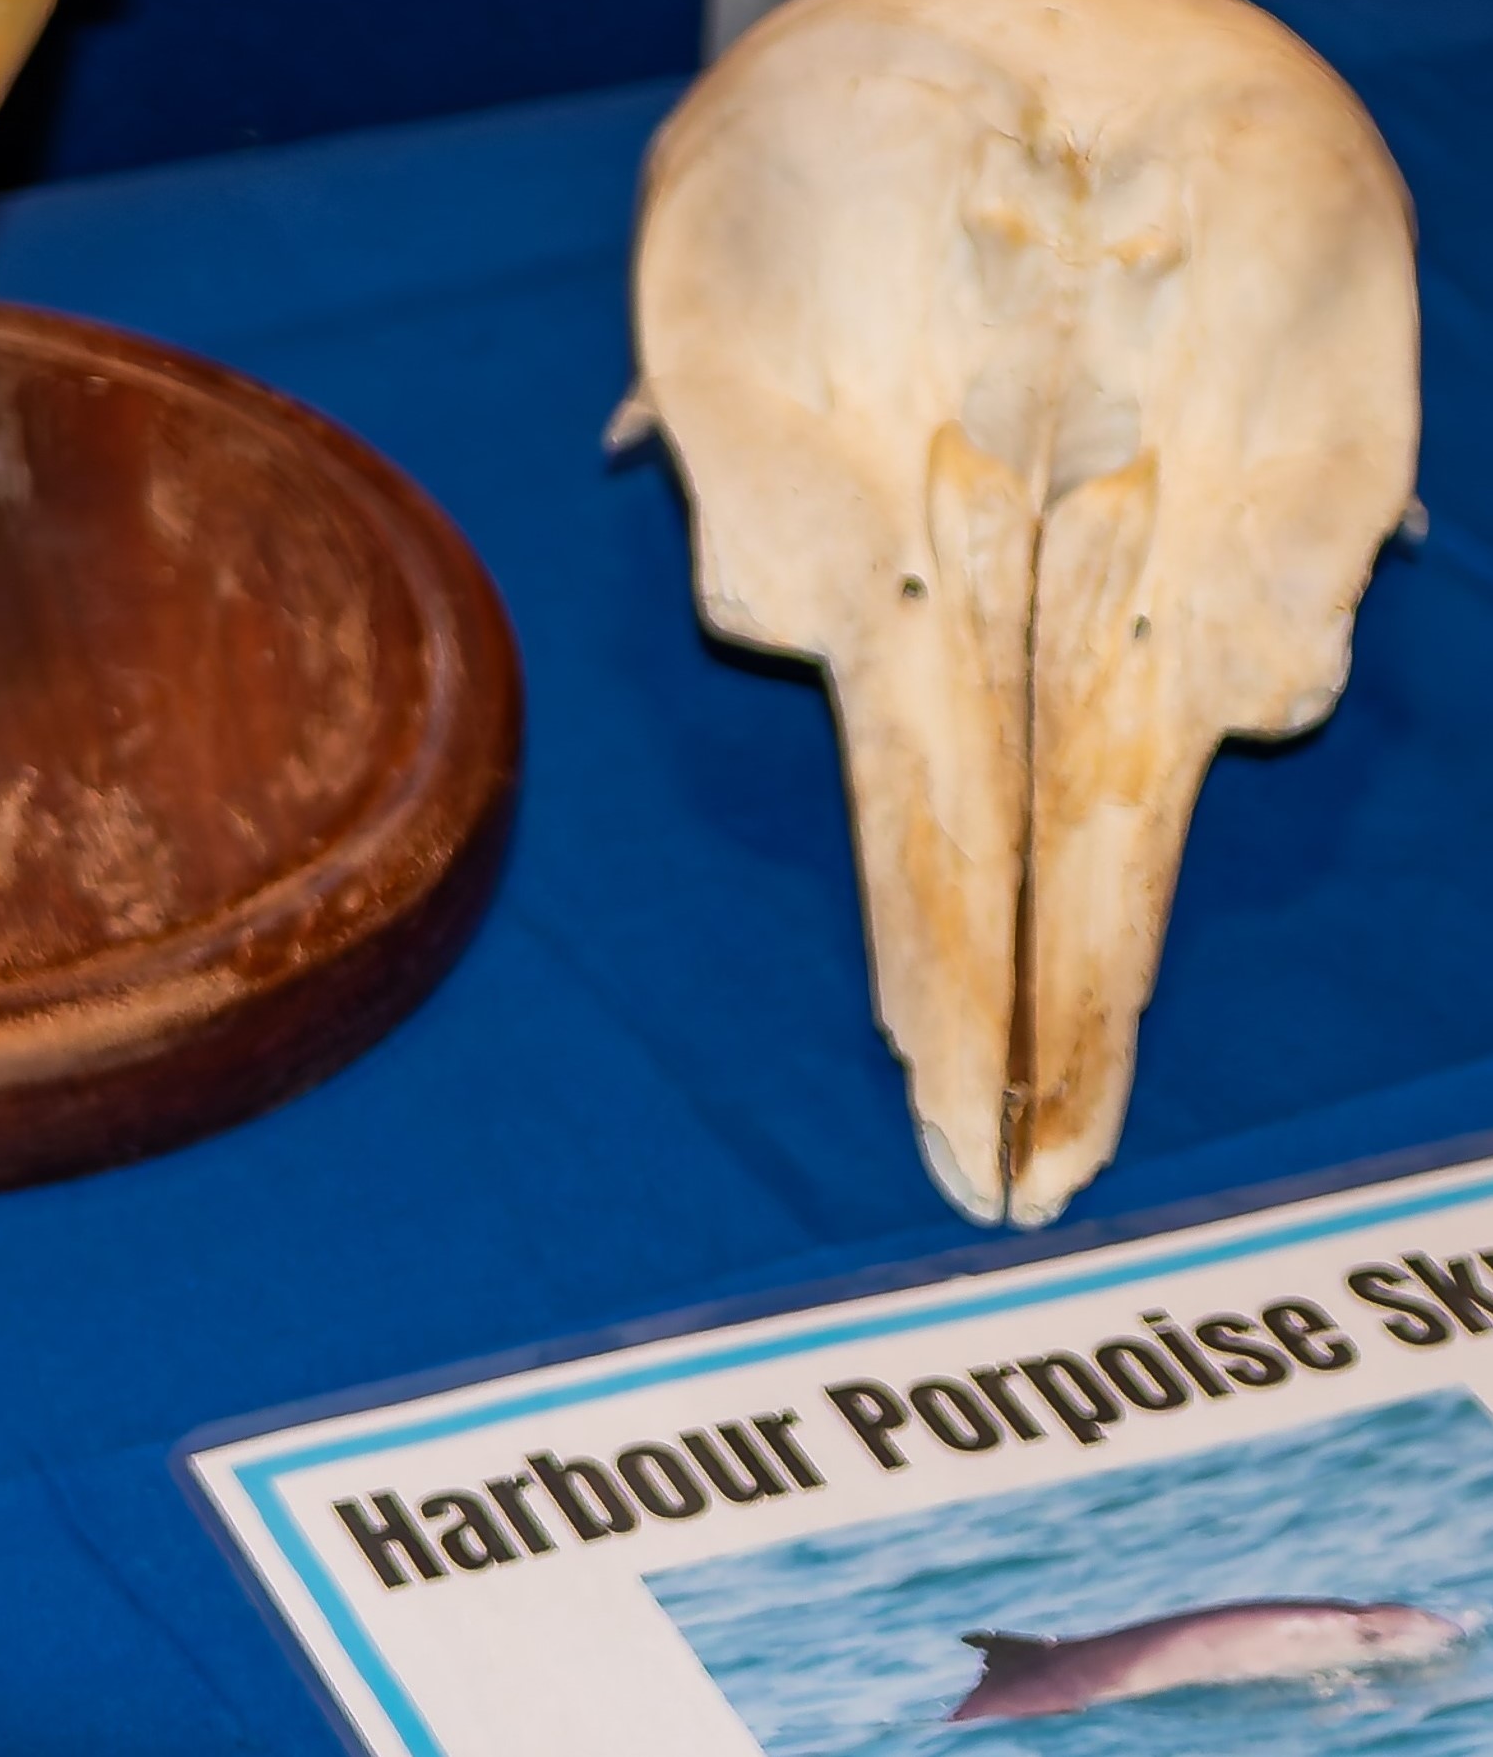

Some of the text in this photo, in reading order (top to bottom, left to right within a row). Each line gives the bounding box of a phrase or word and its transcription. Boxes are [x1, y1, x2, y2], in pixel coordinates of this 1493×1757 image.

[331, 1247, 1493, 1592] Harbour Porpoise Sk
